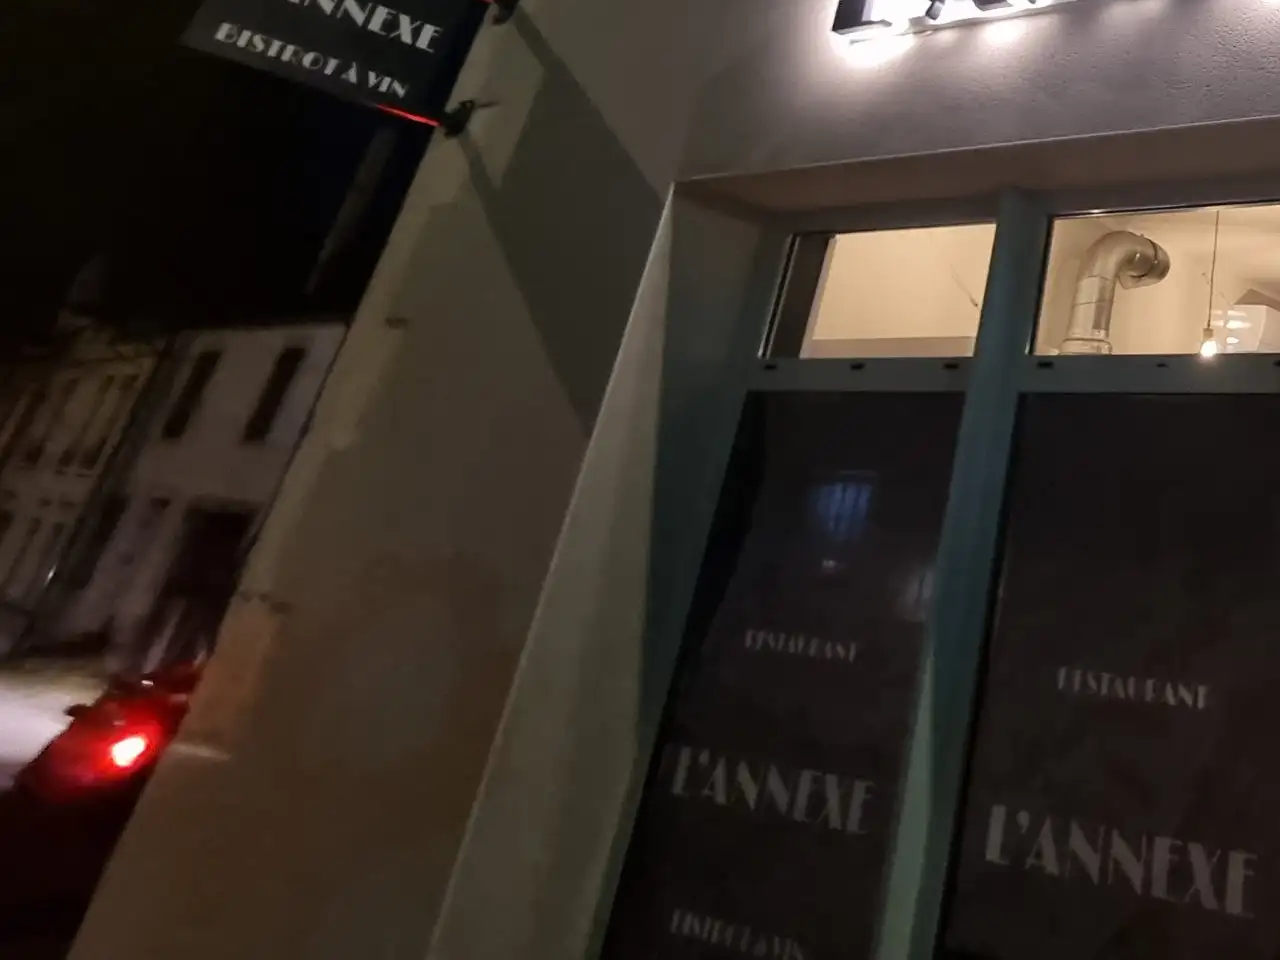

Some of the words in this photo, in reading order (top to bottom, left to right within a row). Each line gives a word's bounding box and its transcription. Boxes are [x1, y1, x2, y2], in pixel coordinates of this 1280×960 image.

[214, 21, 341, 76] BISTROT
[367, 70, 409, 98] VIN
[671, 745, 875, 835] L'ANNEXE
[985, 804, 1257, 919] L'ANNEXE
